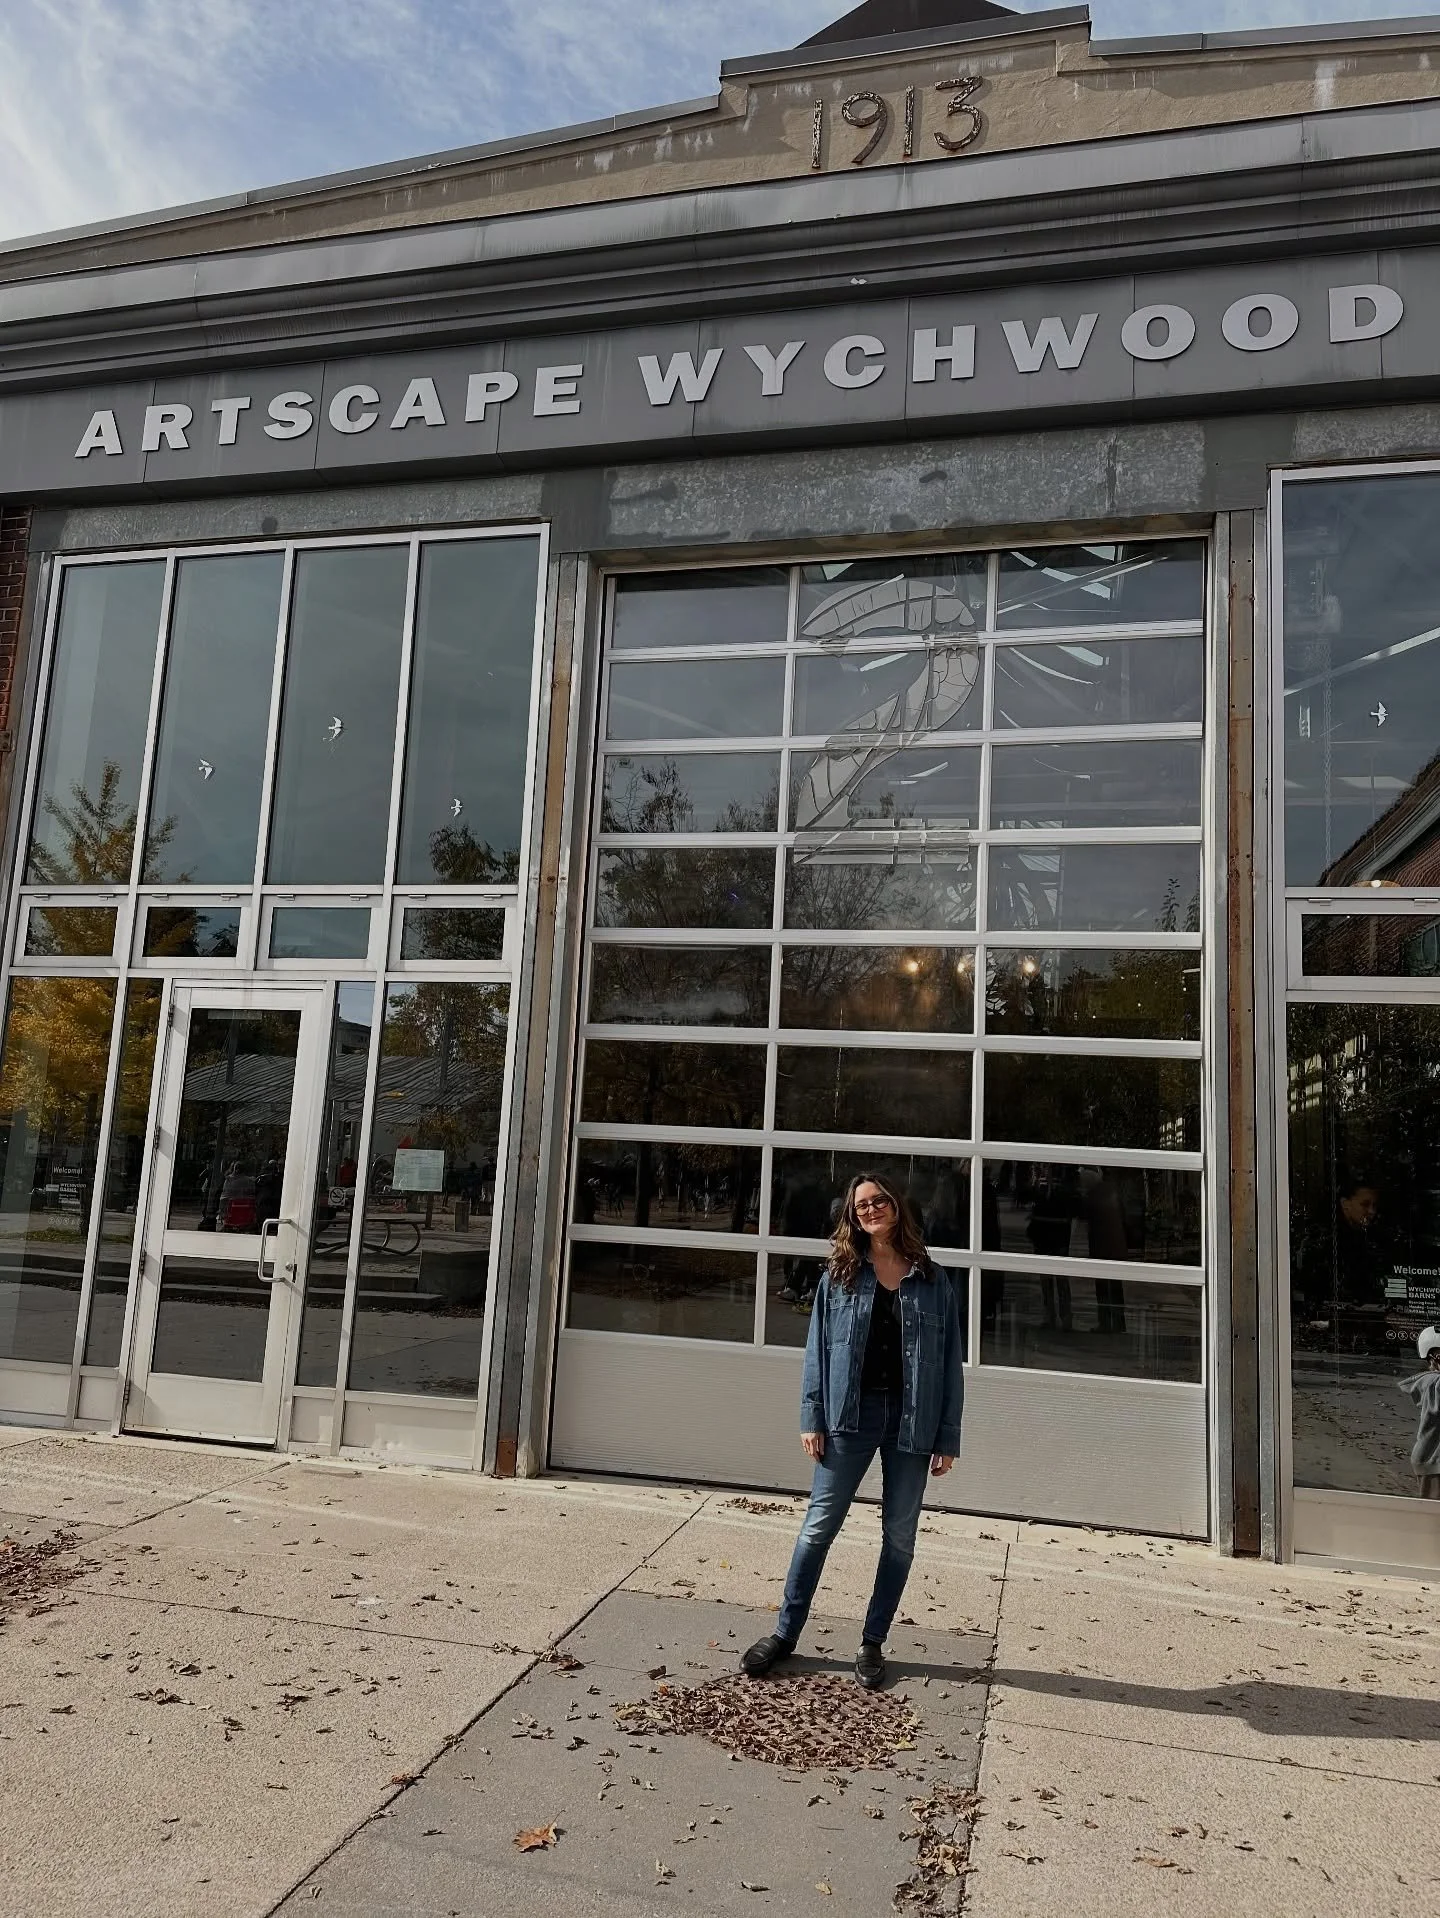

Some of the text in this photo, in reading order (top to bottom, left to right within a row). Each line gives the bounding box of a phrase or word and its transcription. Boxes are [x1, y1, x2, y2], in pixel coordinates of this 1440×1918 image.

[811, 74, 983, 169] 1913
[74, 283, 1404, 459] ARTSCAPE WYCHWOOD
